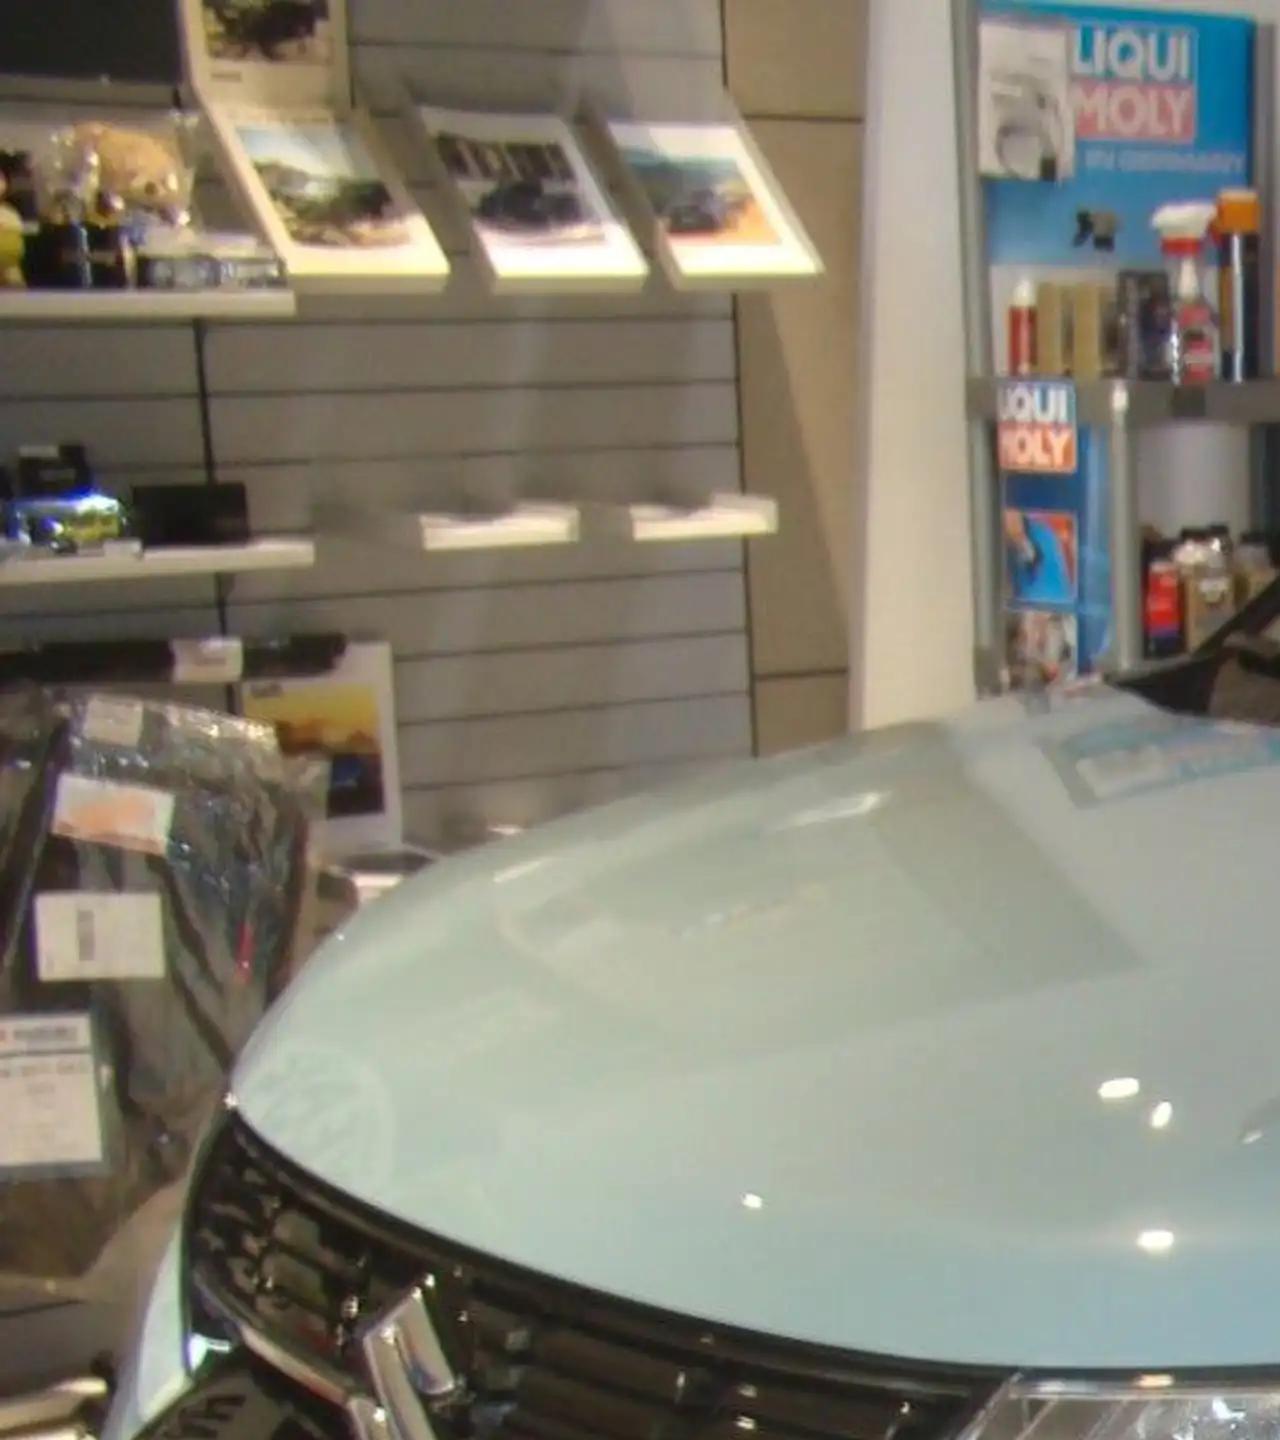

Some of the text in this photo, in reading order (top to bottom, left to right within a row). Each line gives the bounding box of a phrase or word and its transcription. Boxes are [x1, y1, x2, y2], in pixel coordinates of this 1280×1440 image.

[1073, 27, 1191, 82] LIQUI
[1072, 84, 1192, 137] MOLY
[998, 384, 1068, 422] QUI
